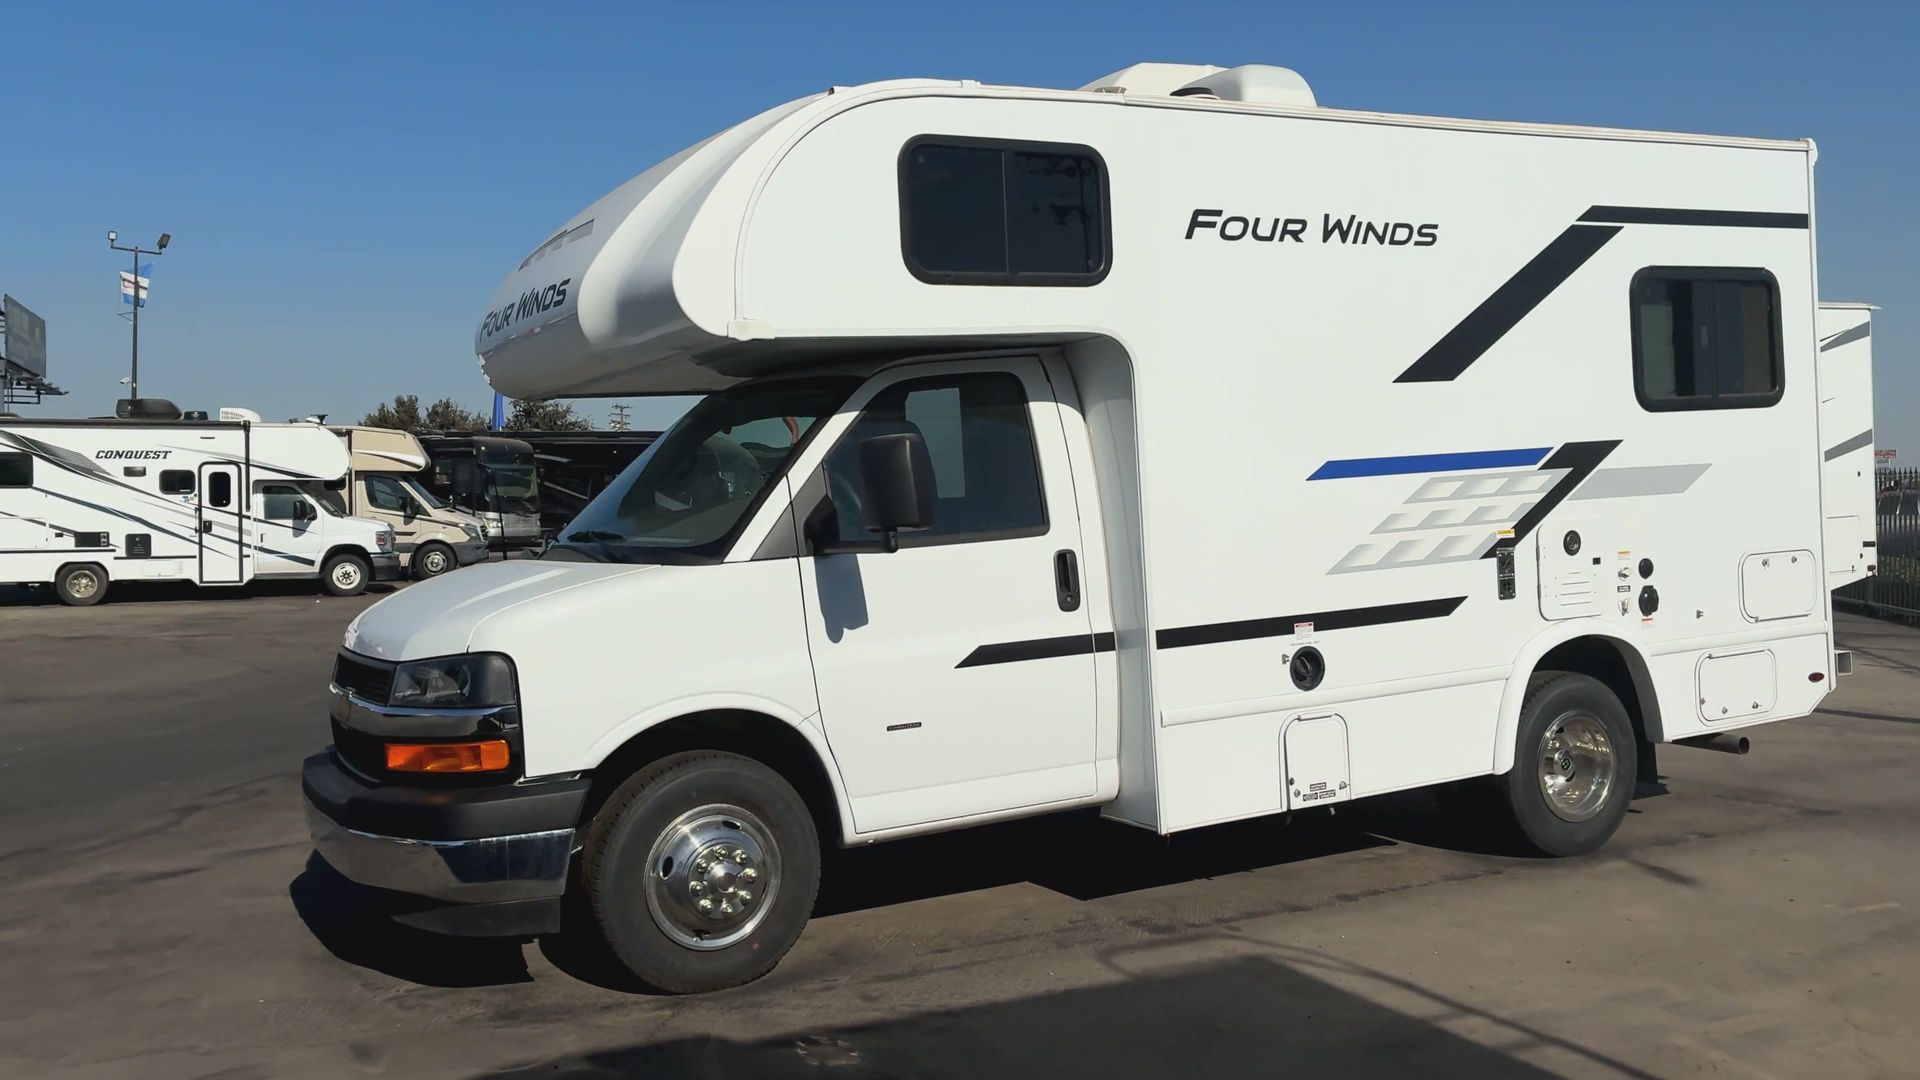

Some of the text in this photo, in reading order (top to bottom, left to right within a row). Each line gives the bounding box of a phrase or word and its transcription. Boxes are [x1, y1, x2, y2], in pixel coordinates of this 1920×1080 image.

[1184, 208, 1439, 246] FOUR WINDS
[479, 278, 571, 342] FOUR WINDS
[95, 450, 172, 459] CONQUEST
